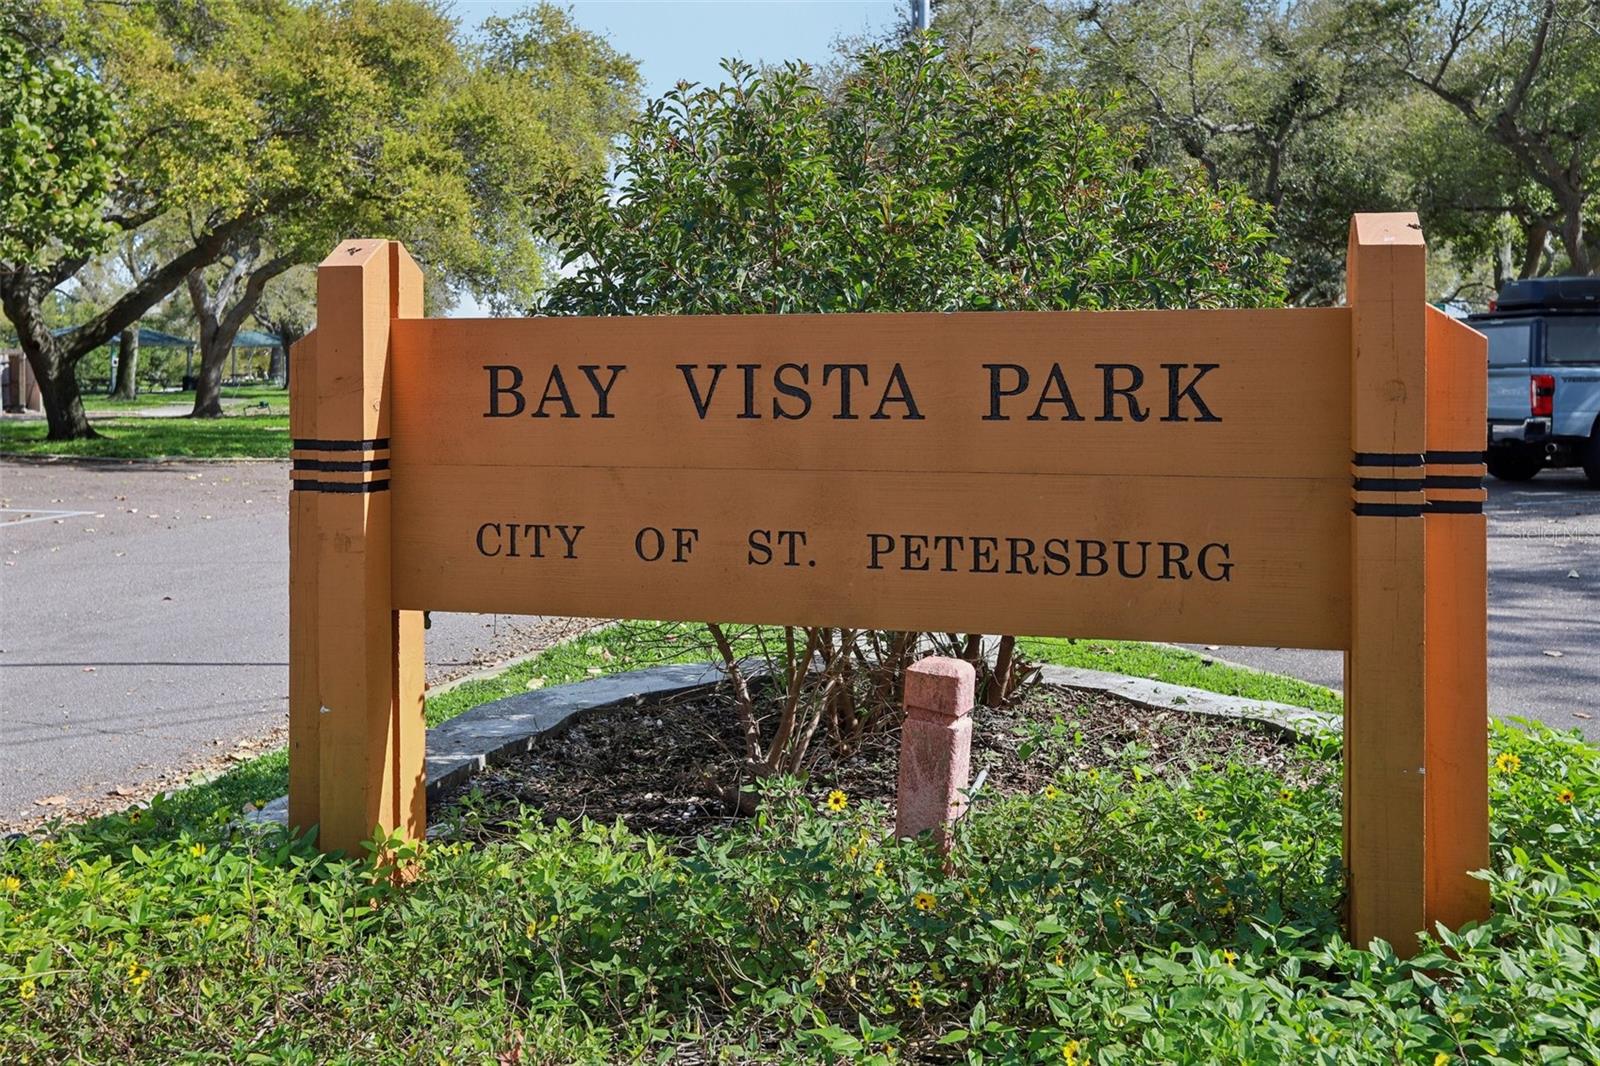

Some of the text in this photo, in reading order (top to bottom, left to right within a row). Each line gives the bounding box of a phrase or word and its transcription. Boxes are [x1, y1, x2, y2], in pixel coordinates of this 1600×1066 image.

[484, 363, 1223, 423] BAY VISTA PARK
[477, 523, 1235, 582] CITY OF ST. PETERSBURG
